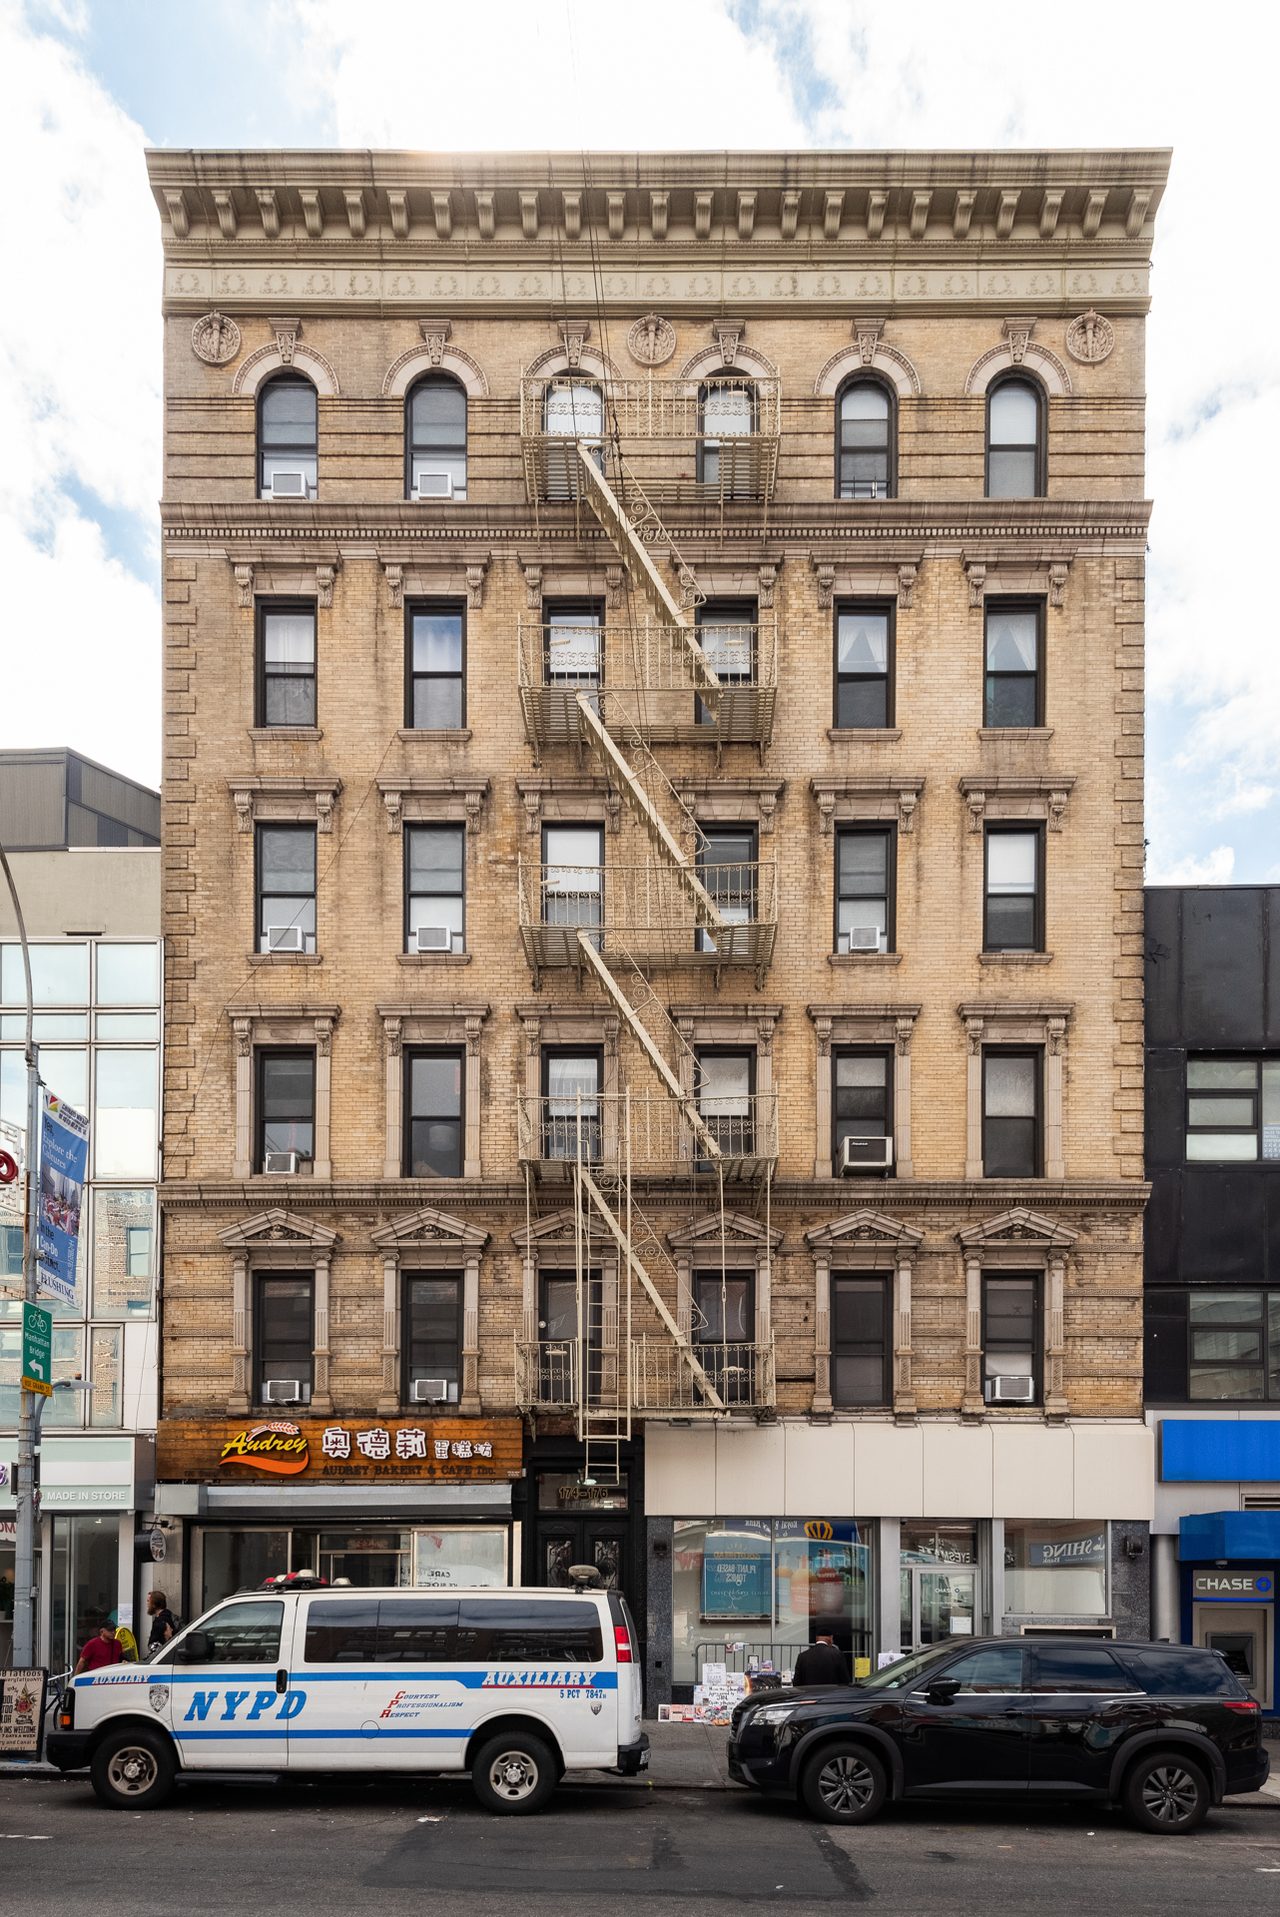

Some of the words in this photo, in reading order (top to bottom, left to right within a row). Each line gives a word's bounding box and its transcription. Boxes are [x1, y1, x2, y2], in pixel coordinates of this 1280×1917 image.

[43, 1132, 65, 1155] Explore
[66, 1148, 78, 1163] the
[41, 1272, 74, 1299] FLUSHING
[24, 1332, 50, 1348] Manhattan
[29, 1346, 45, 1360] Bridge
[221, 1432, 308, 1457] Audrey
[322, 1466, 369, 1476] AUDREY
[376, 1466, 423, 1476] BAKERY
[428, 1466, 435, 1476] &
[441, 1466, 472, 1476] CAFE
[48, 1492, 76, 1500] MADE
[79, 1492, 88, 1500] IN
[91, 1491, 126, 1500] STORE
[560, 1487, 608, 1498] 174-176
[1196, 1578, 1254, 1590] CHASE
[92, 1674, 150, 1684] AUXILIARY
[482, 1671, 596, 1686] AUXILIARY
[560, 1690, 564, 1698] 5
[567, 1690, 580, 1698] PCT
[184, 1691, 307, 1720] NYPD
